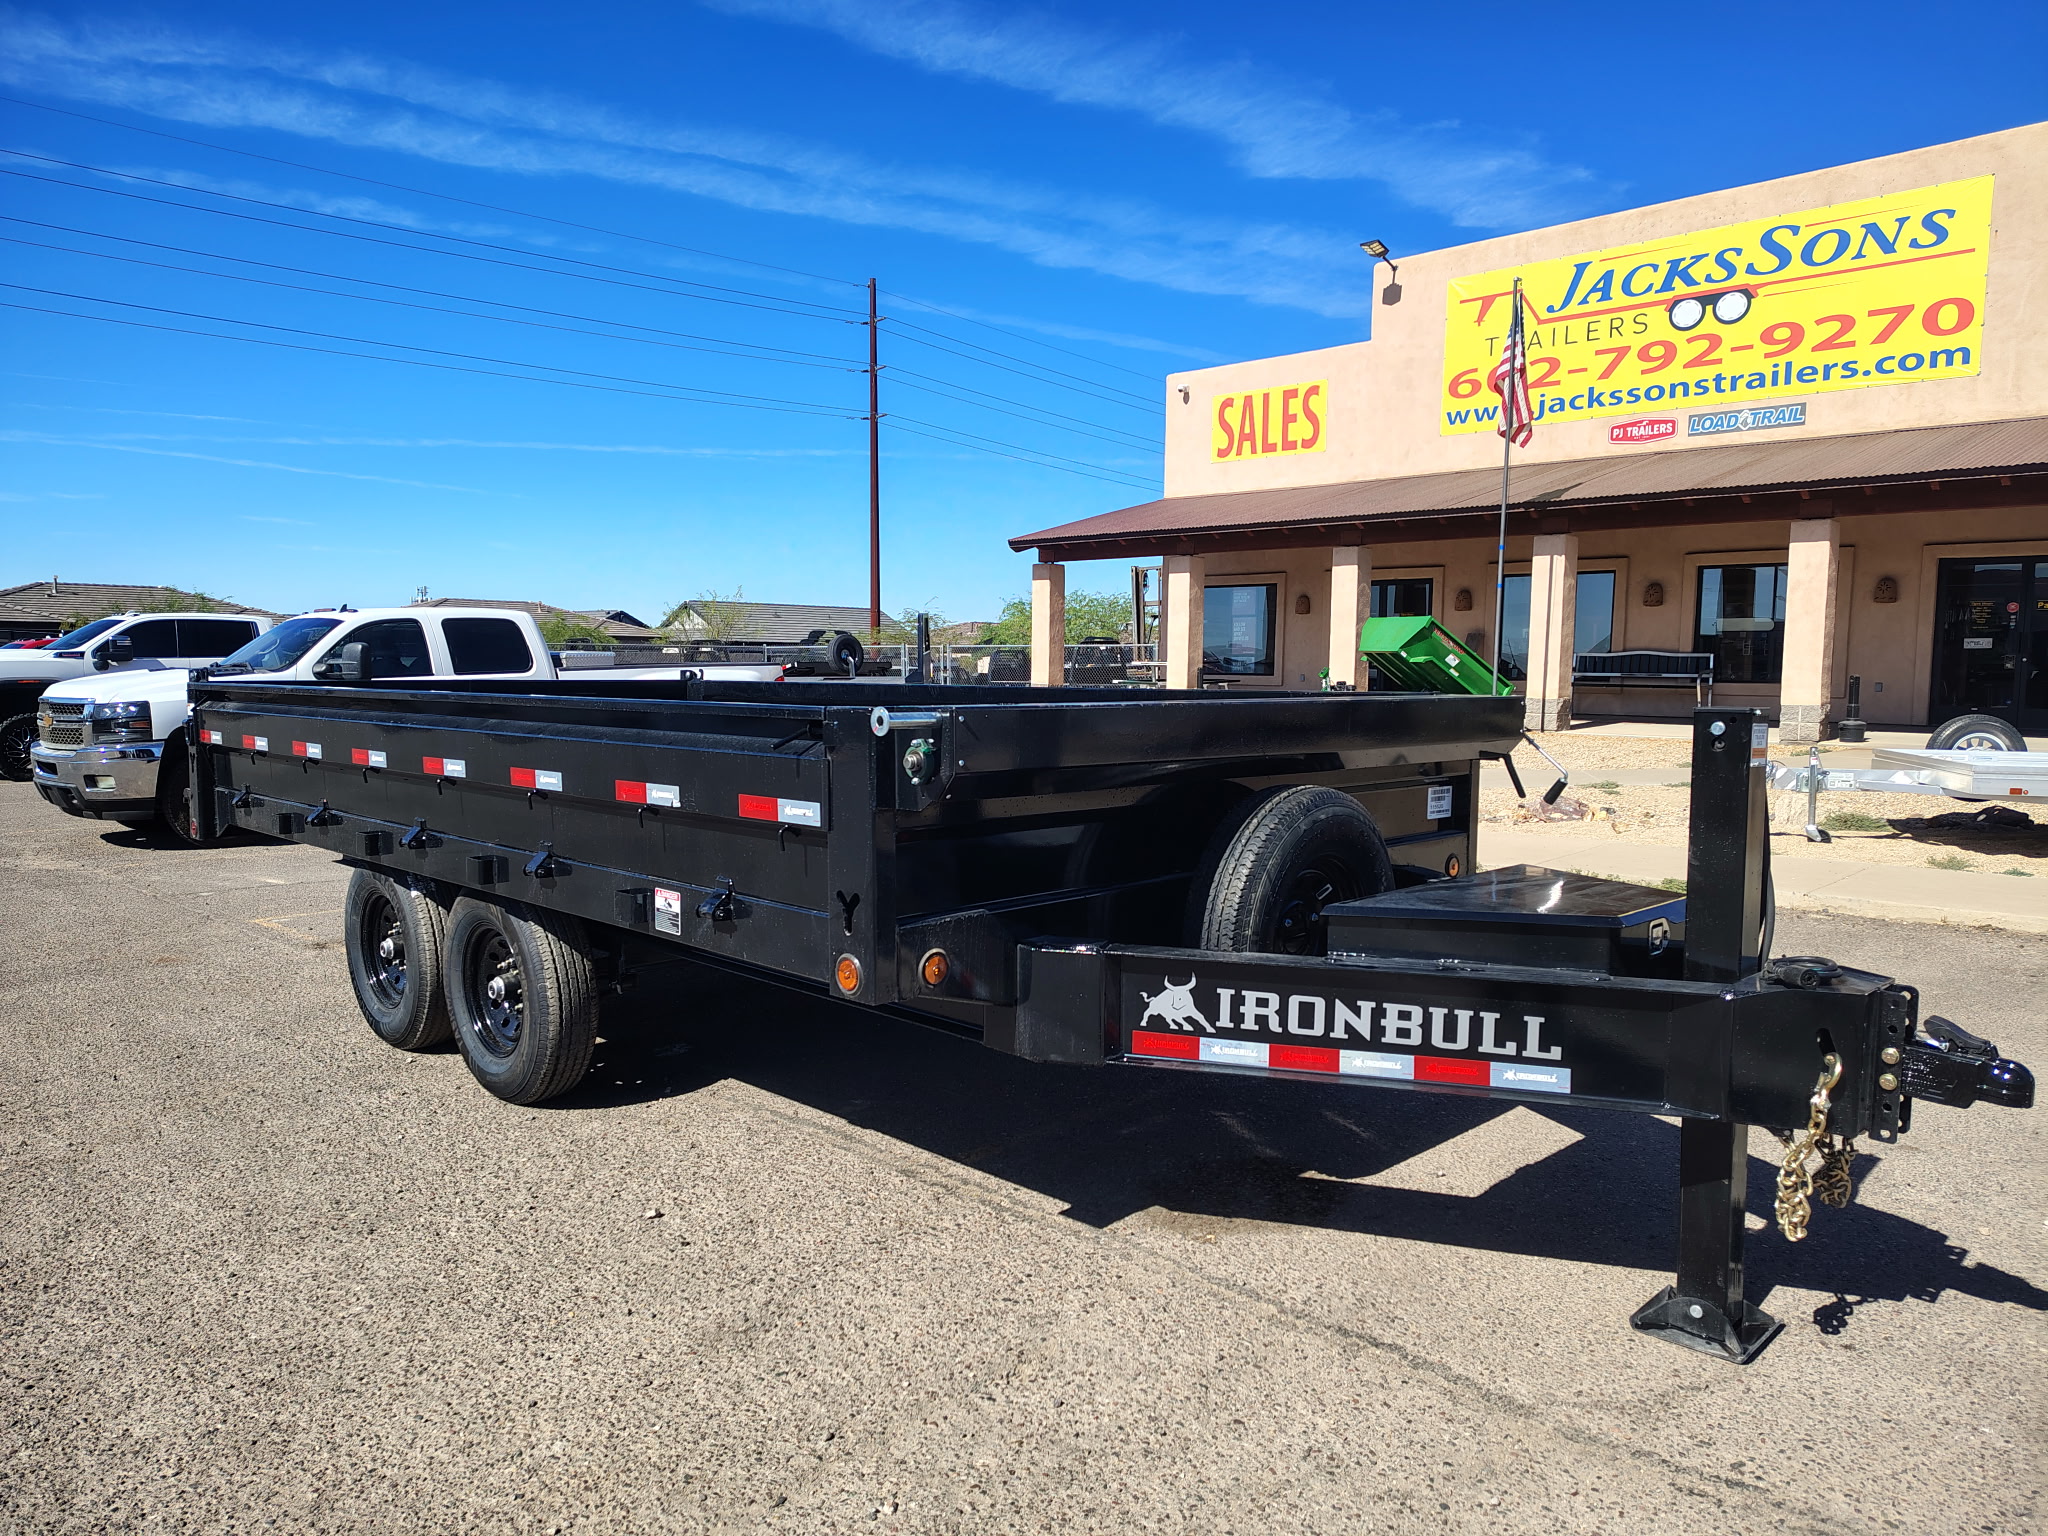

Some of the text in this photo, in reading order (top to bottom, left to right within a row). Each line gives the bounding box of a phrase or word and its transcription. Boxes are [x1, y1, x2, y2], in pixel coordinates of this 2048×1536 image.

[1485, 312, 1648, 357] TAILERS
[1446, 346, 1971, 425] ww.jackssonstrailers.com
[1216, 384, 1320, 459] SALES
[1612, 422, 1673, 439] PJ TRAILERS
[1689, 406, 1804, 433] LOAD TRAIL
[1216, 987, 1562, 1061] IRONBULL
